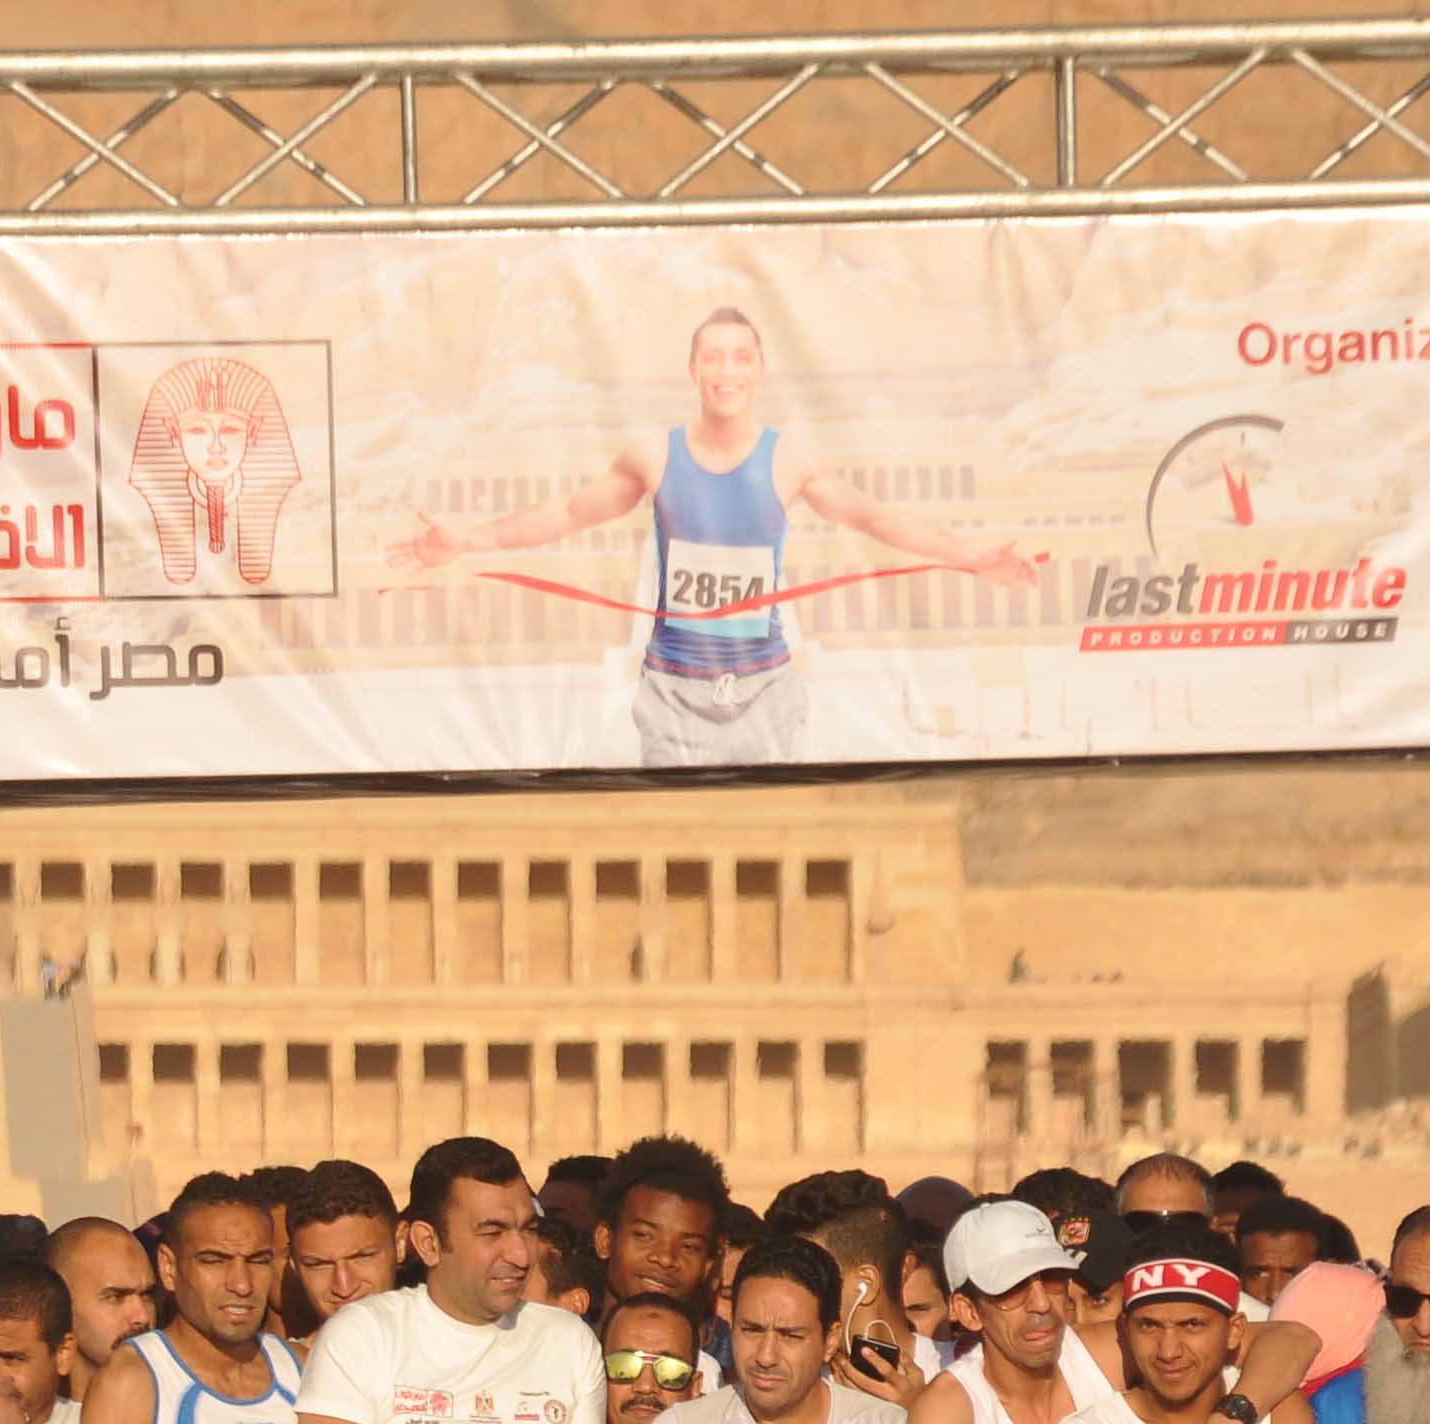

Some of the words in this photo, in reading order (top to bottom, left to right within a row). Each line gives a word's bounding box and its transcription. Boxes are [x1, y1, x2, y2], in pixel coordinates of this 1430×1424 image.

[672, 567, 766, 611] 2854
[1088, 556, 1406, 620] lastminute
[1090, 621, 1278, 649] PRODUCTION
[1293, 618, 1390, 642] HOUSE
[89, 638, 224, 701] مصر
[1131, 1263, 1212, 1292] NY
